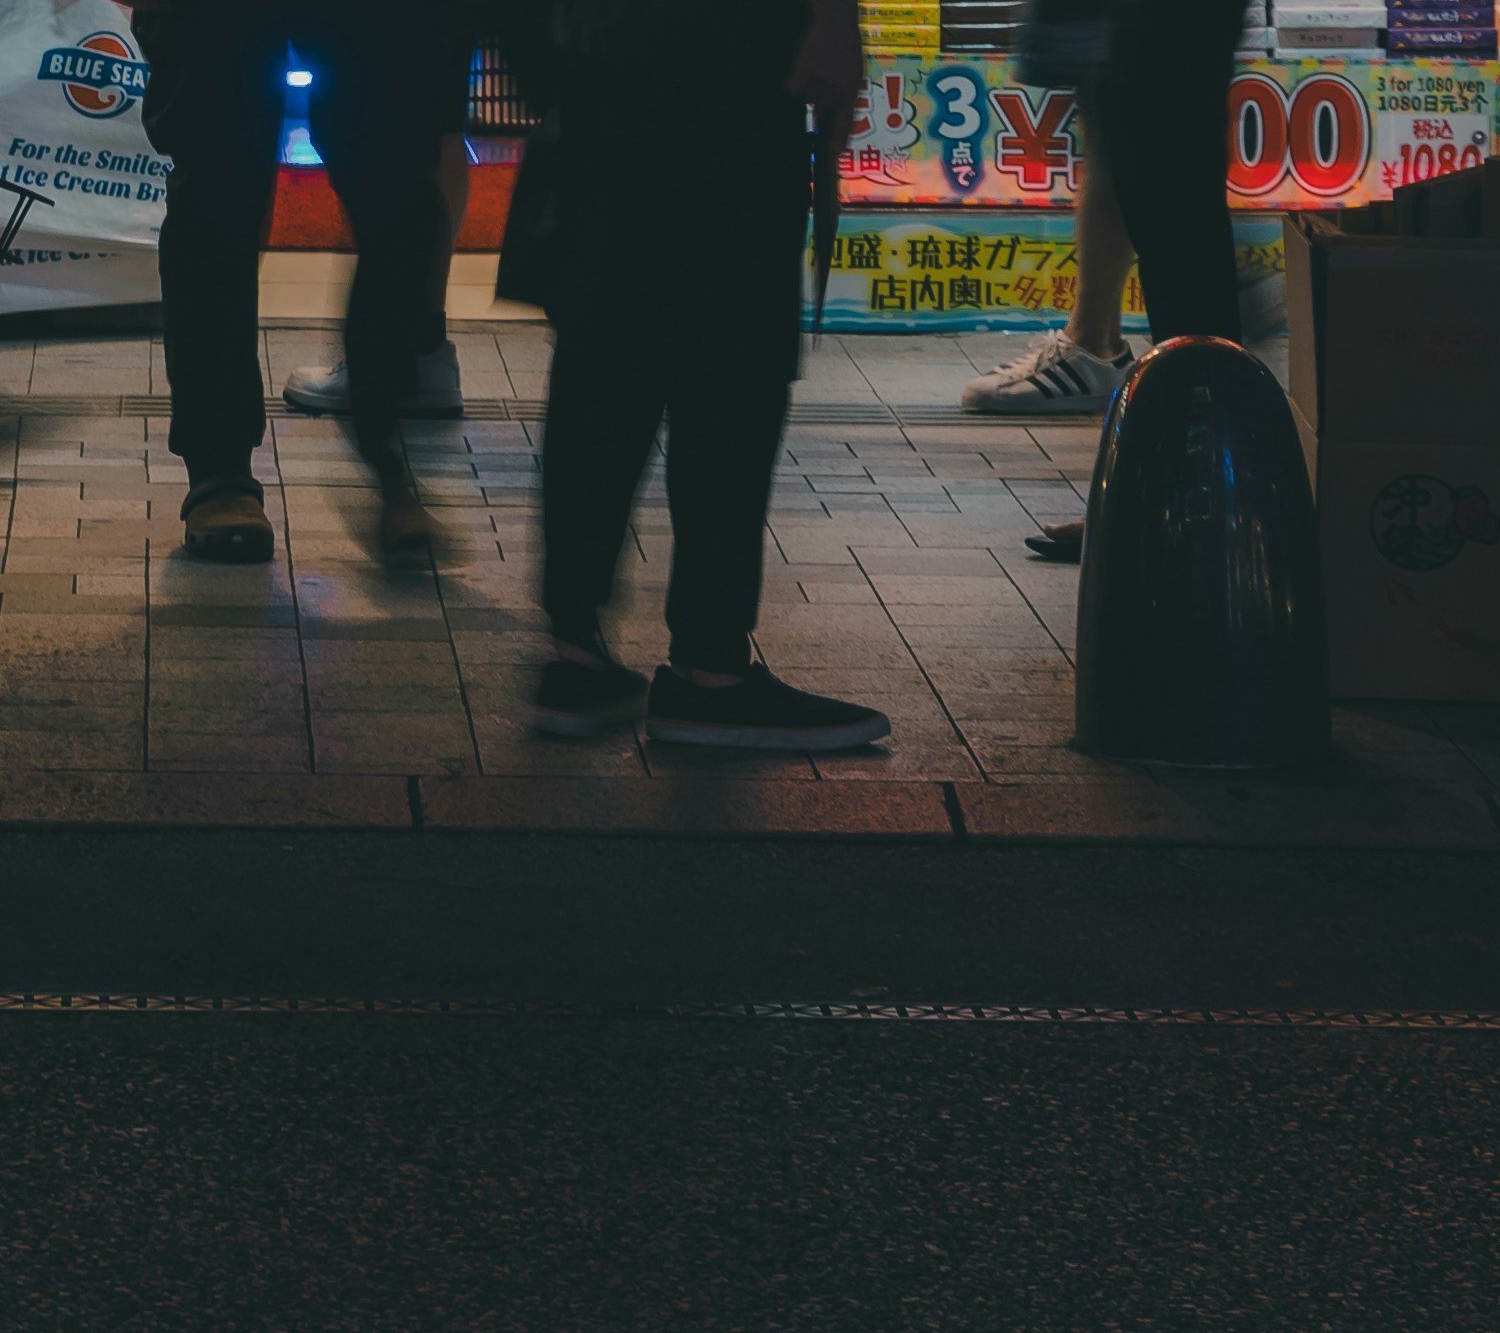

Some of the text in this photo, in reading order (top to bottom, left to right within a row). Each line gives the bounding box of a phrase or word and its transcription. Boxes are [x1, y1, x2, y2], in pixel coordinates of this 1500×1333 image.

[49, 52, 151, 88] BLUE SEA
[1377, 77, 1485, 98] 3 for 1080 yen
[936, 76, 981, 139] 3
[9, 137, 172, 178] For the Smiles
[13, 165, 49, 188] Ice
[52, 169, 131, 199] Cream
